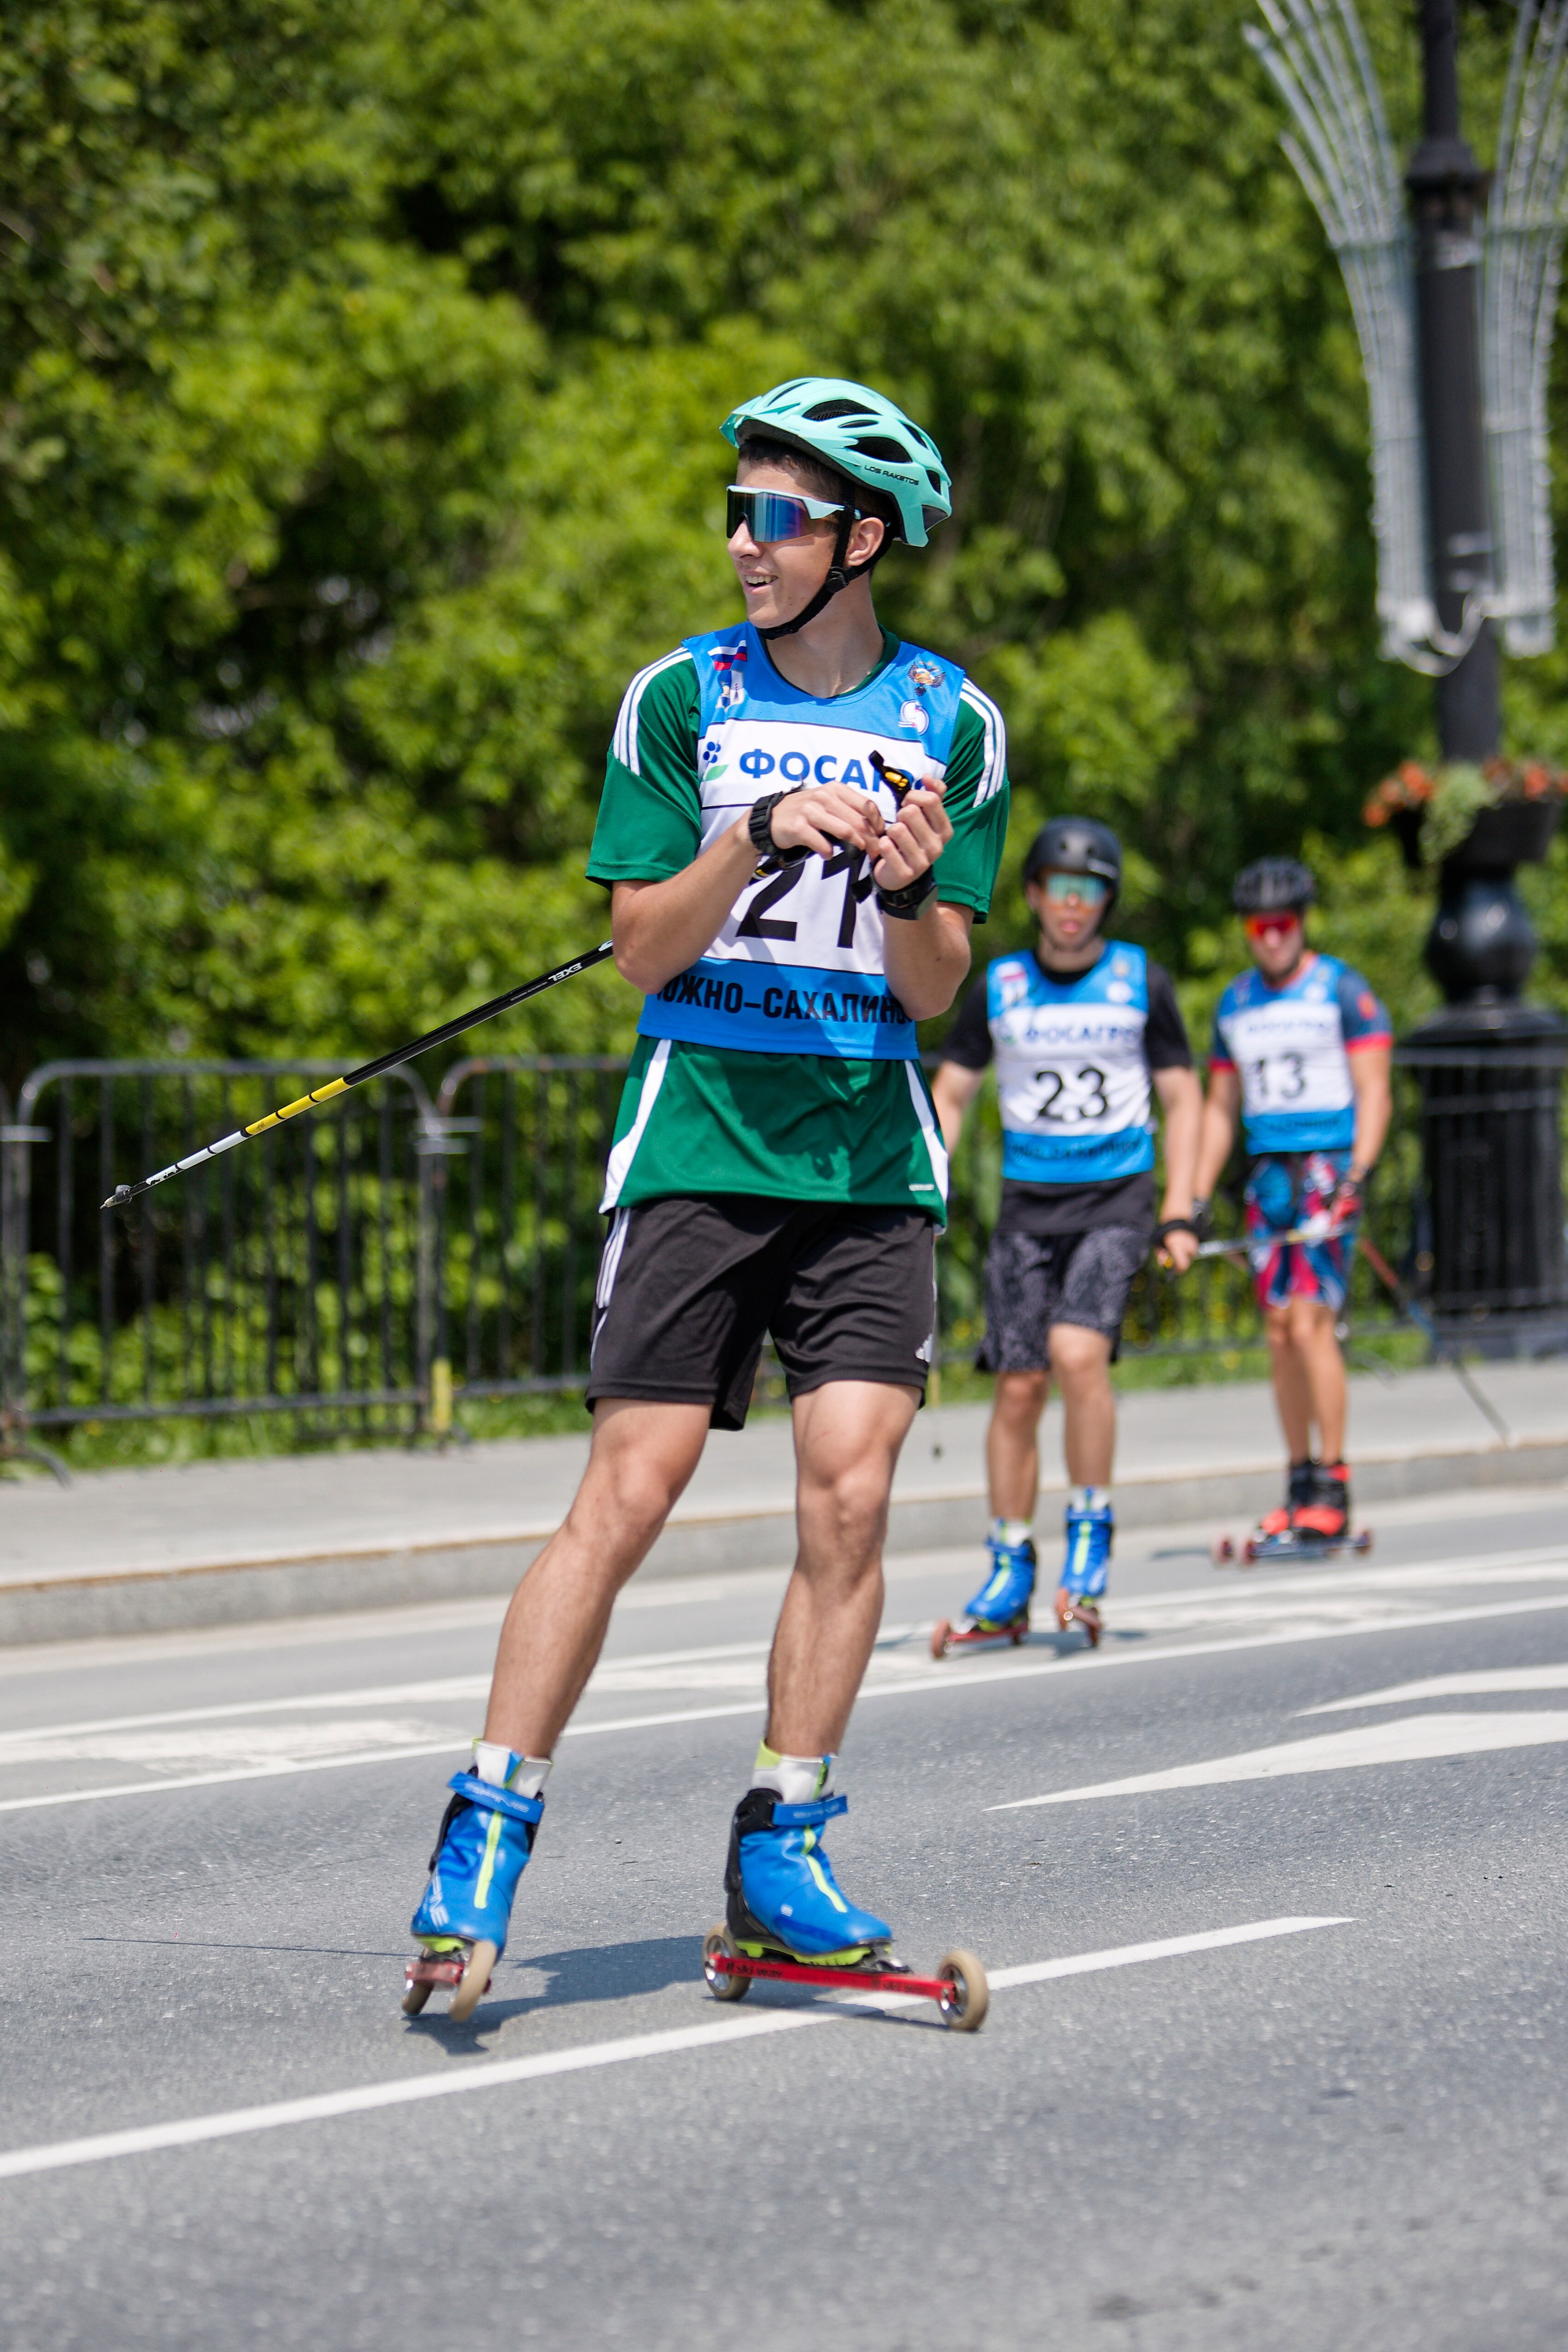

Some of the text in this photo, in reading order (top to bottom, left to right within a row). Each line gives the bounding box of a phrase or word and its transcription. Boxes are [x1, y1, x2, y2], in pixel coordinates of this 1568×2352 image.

[864, 464, 920, 486] LOS RAKETOS
[735, 850, 866, 949] 21
[548, 962, 582, 982] EXEL
[1036, 1068, 1107, 1120] 23
[1251, 1050, 1305, 1099] 13
